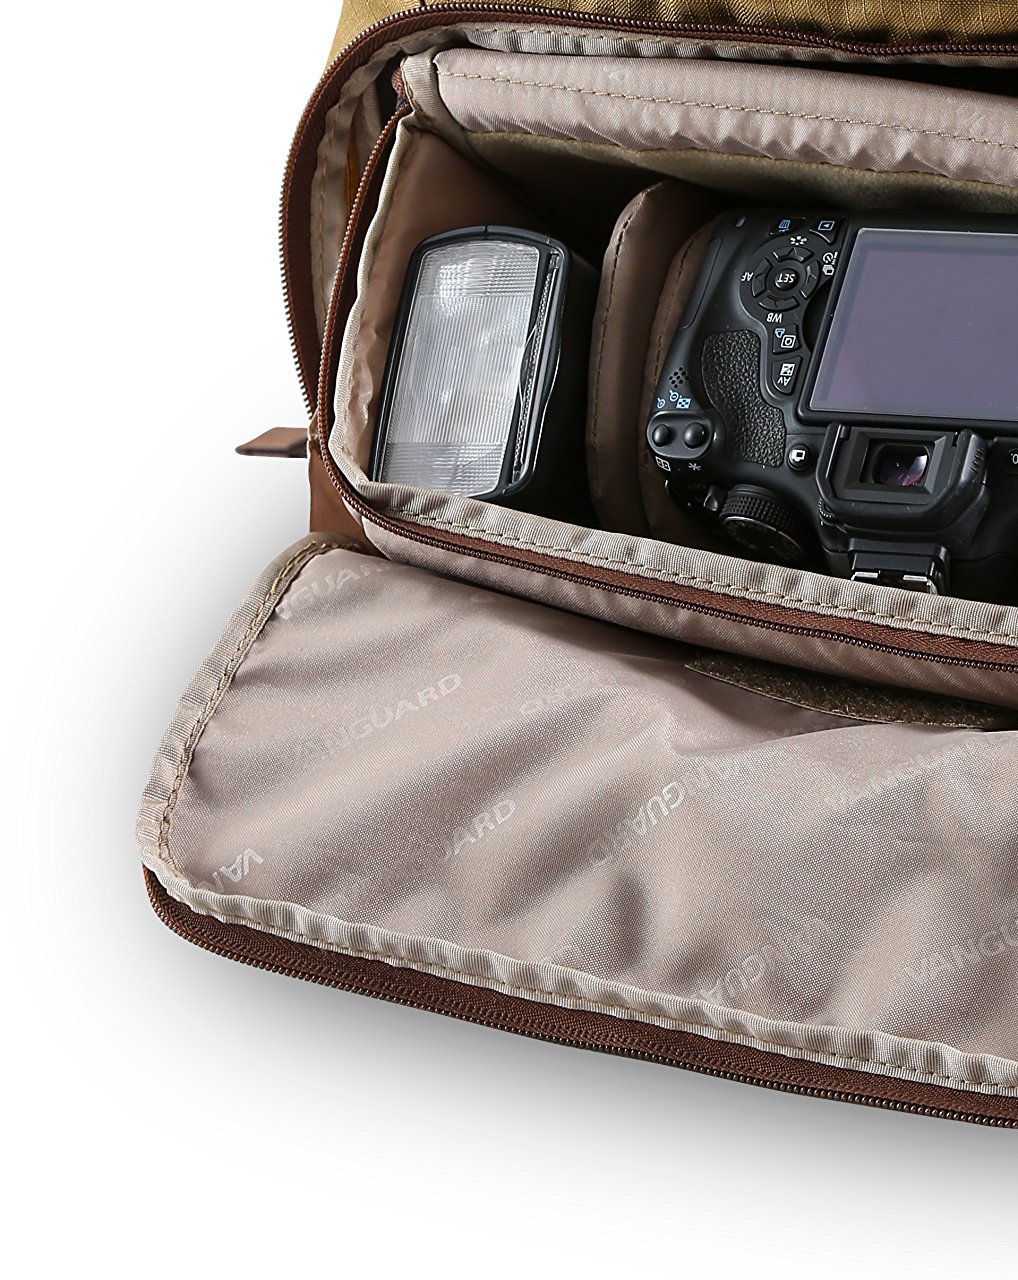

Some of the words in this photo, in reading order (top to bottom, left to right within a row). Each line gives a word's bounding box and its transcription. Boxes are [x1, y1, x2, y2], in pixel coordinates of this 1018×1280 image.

[741, 271, 754, 282] AF
[777, 273, 796, 283] SET
[766, 313, 783, 323] WB
